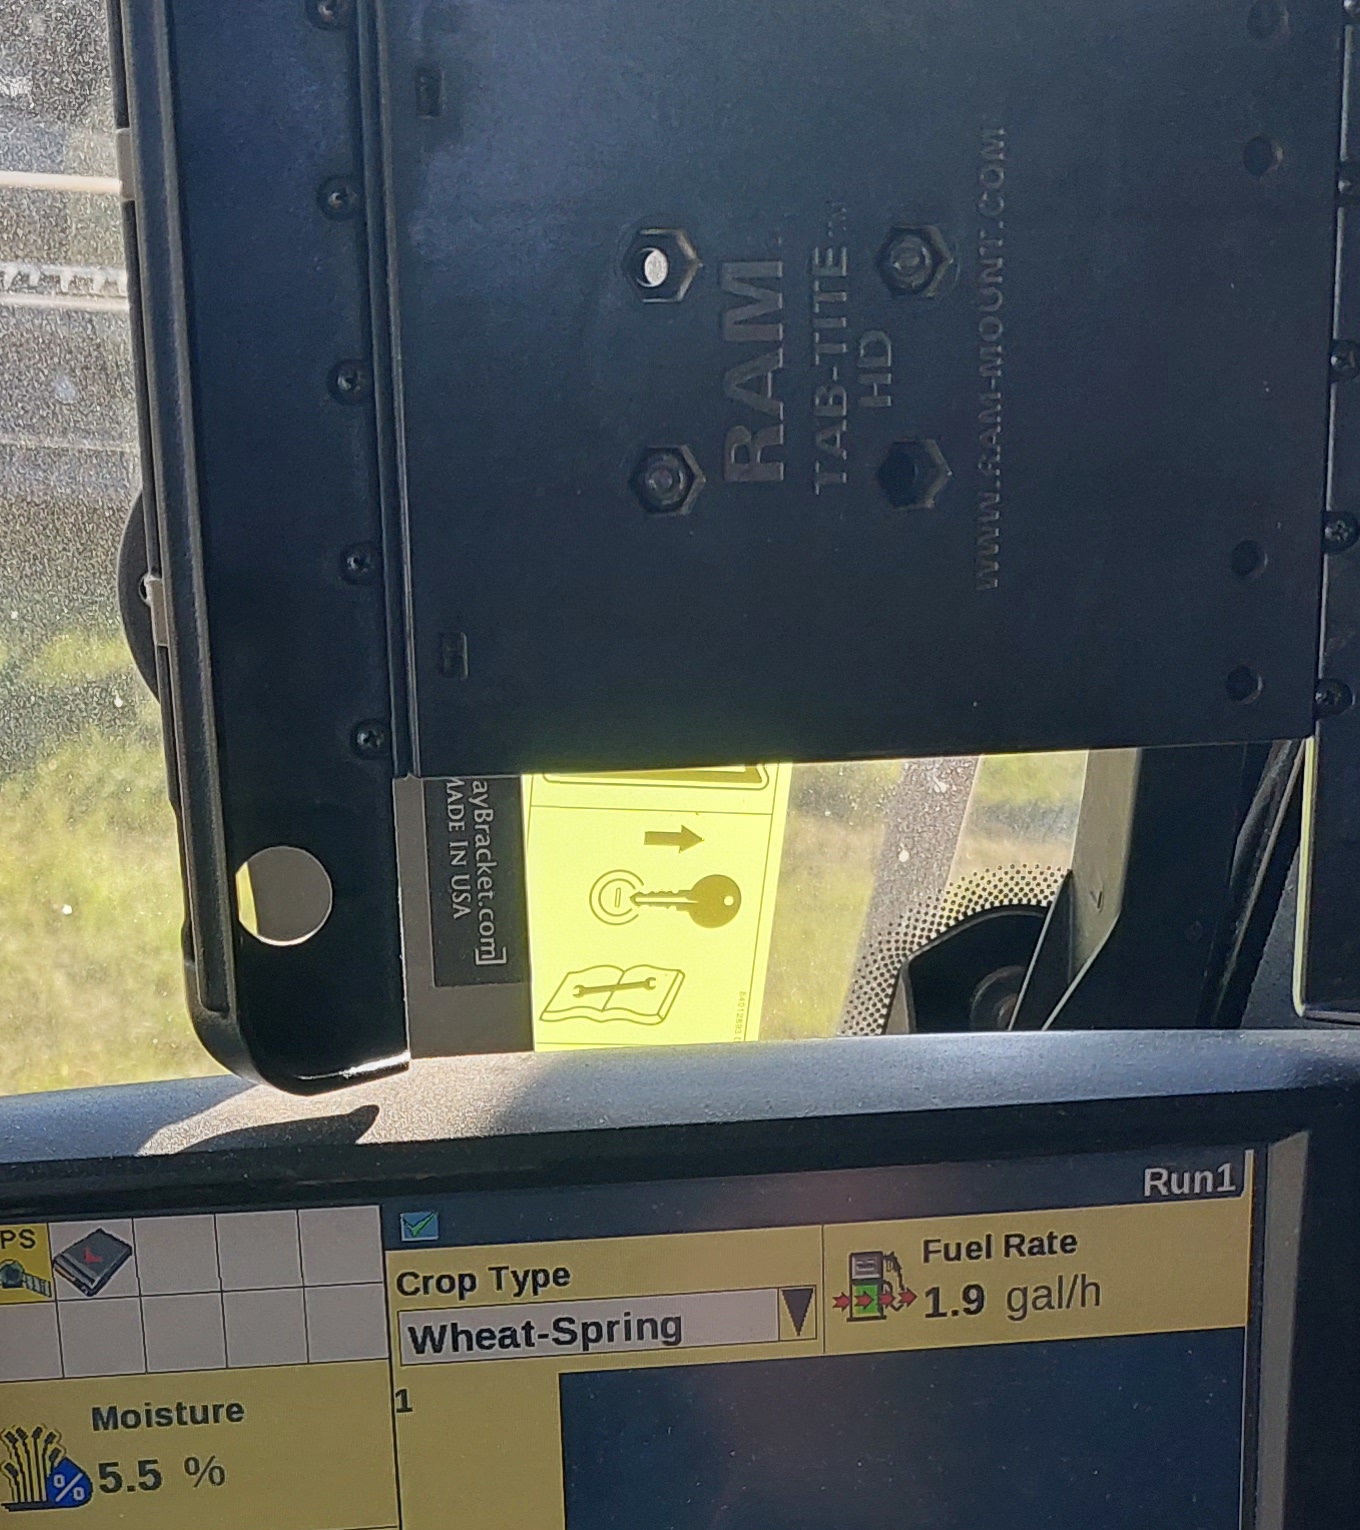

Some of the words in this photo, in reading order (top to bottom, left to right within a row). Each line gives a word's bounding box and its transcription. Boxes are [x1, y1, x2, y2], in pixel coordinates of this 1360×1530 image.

[721, 260, 785, 483] RAM
[856, 330, 893, 407] HD
[976, 126, 1009, 592] WWW.RAM-MOUNT.COM
[449, 841, 469, 866] IN
[451, 874, 472, 919] USA
[1144, 1163, 1237, 1198] Run1
[922, 1233, 993, 1264] Fuel
[1004, 1230, 1078, 1260] Rate
[397, 1270, 477, 1299] Crop
[490, 1263, 572, 1295] Type
[925, 1283, 986, 1319] 1.9
[1007, 1273, 1103, 1321] gal/h
[408, 1309, 684, 1356] Wheat-Spring
[91, 1399, 246, 1432] Moisture
[395, 1388, 414, 1414] 1
[98, 1457, 163, 1495] 5.5
[184, 1454, 227, 1488] %
